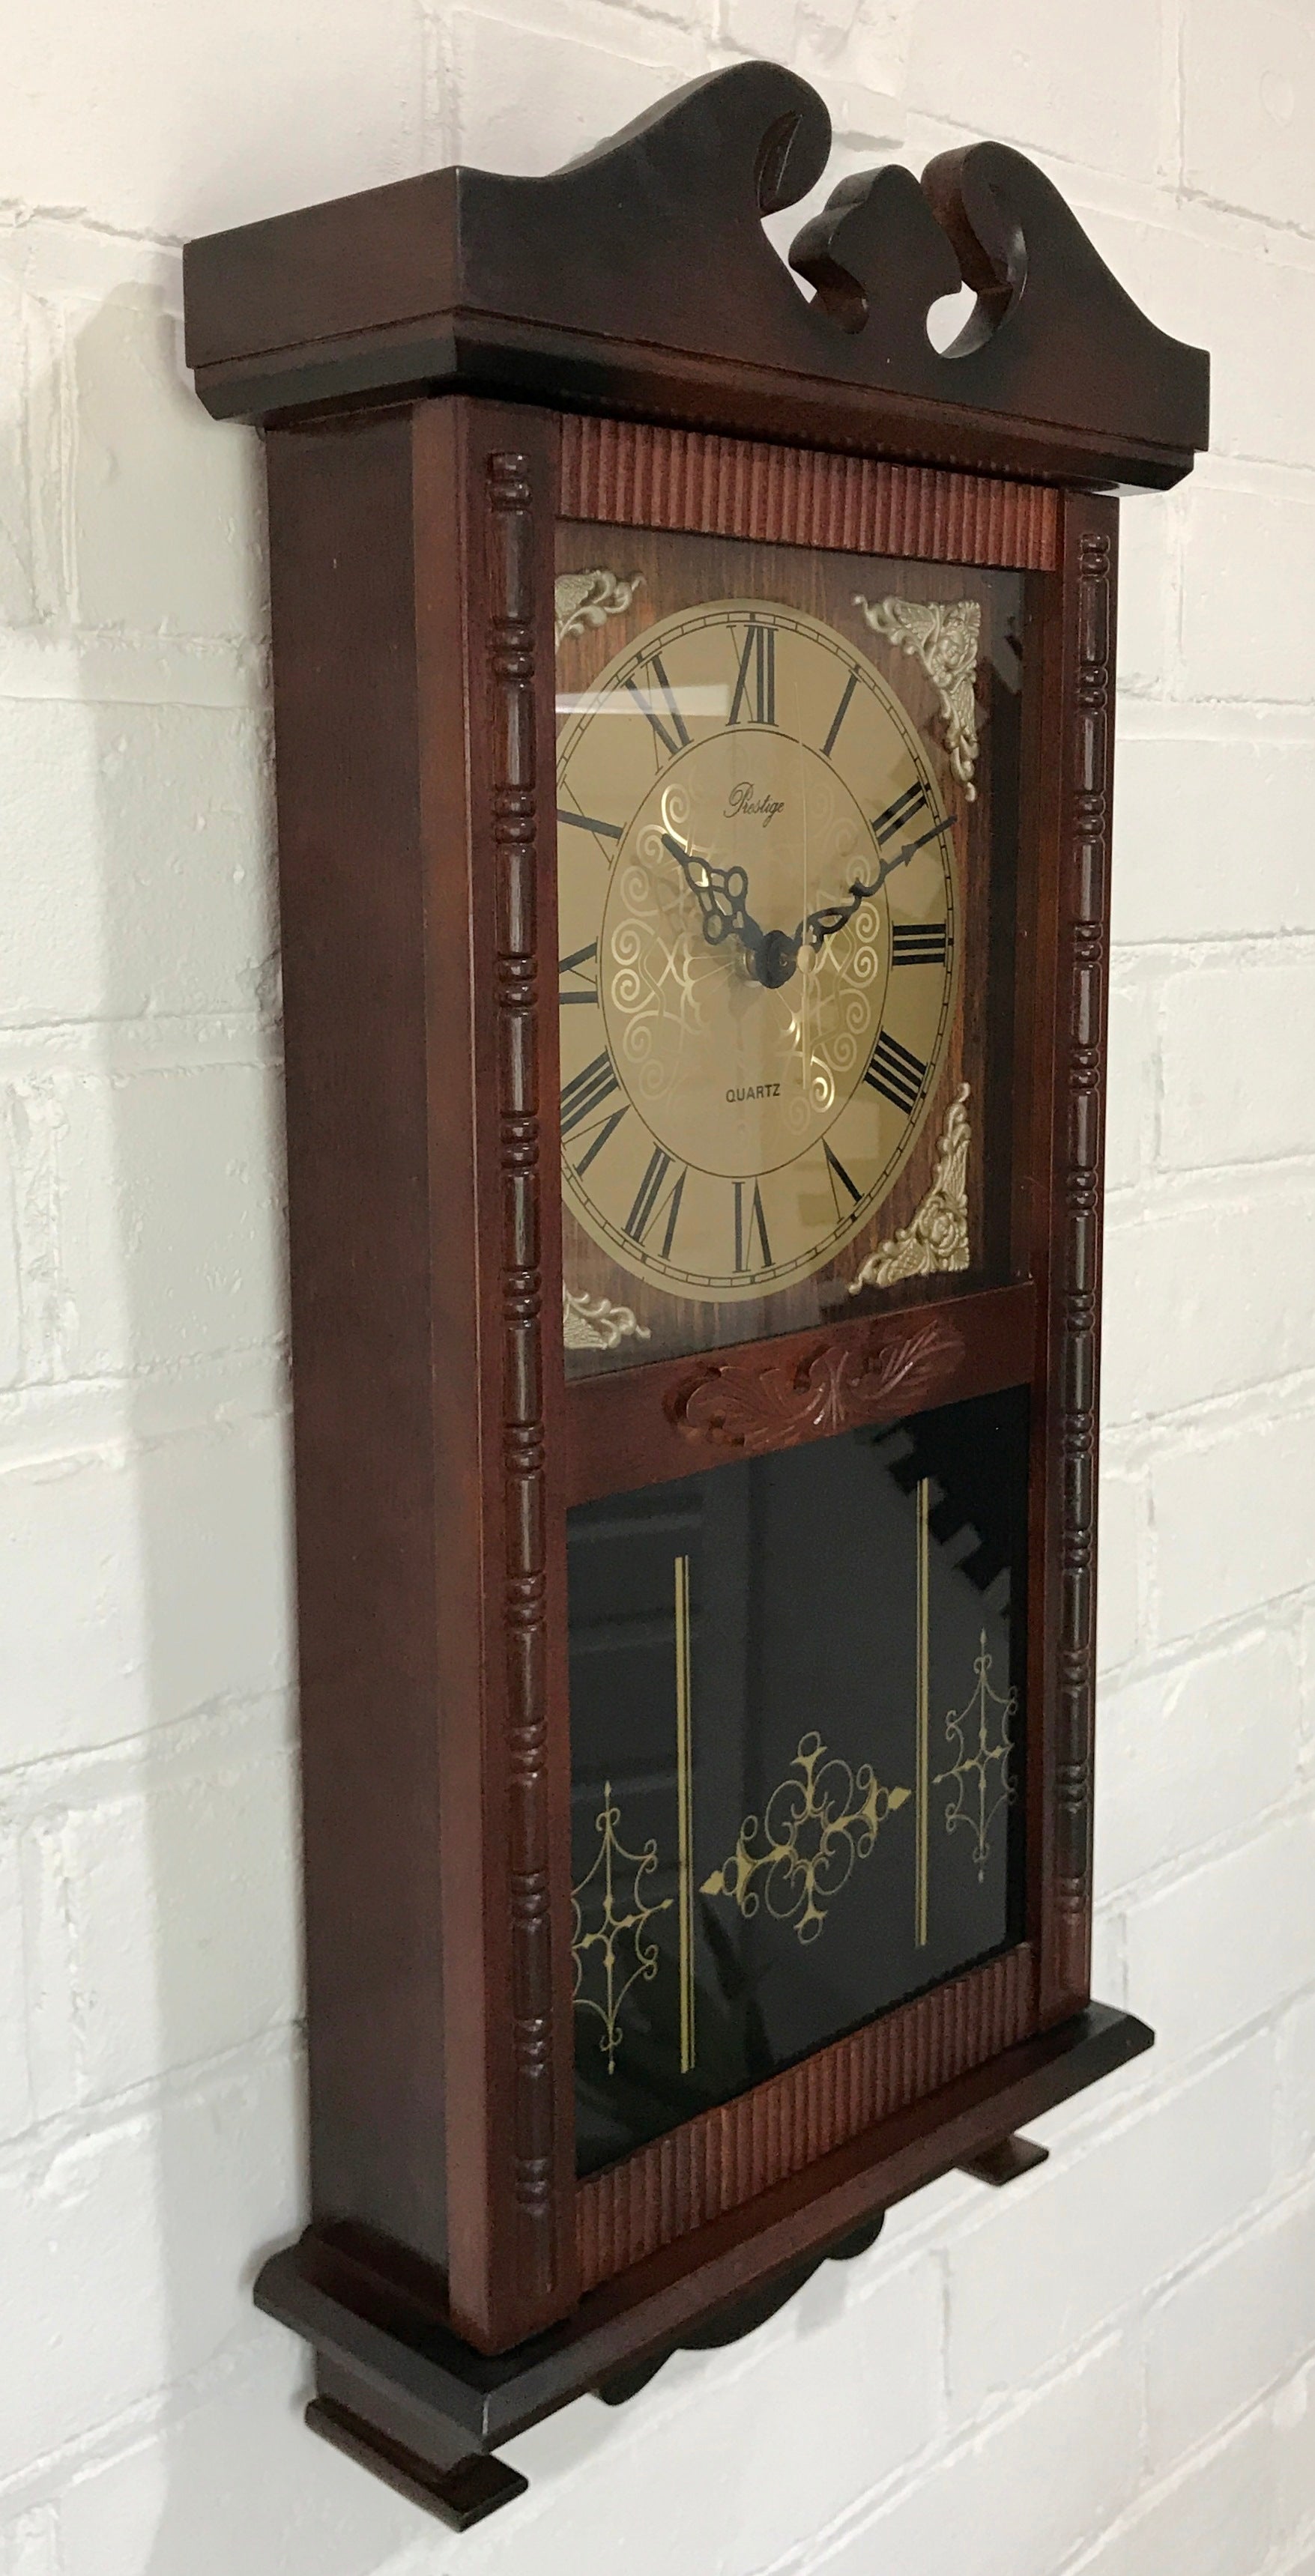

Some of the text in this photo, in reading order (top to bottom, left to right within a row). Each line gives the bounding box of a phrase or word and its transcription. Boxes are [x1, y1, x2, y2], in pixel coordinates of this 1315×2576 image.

[623, 651, 695, 775] XI
[725, 623, 779, 727] XII
[819, 669, 863, 760] I
[556, 773, 628, 871] X
[723, 781, 785, 828] Prestige
[868, 775, 929, 852] II
[890, 919, 946, 972] III
[725, 1082, 782, 1103] QUARTZ
[862, 1025, 928, 1120] IIII
[621, 1141, 689, 1262] VII
[731, 1176, 776, 1273] VI
[821, 1135, 865, 1225] V
